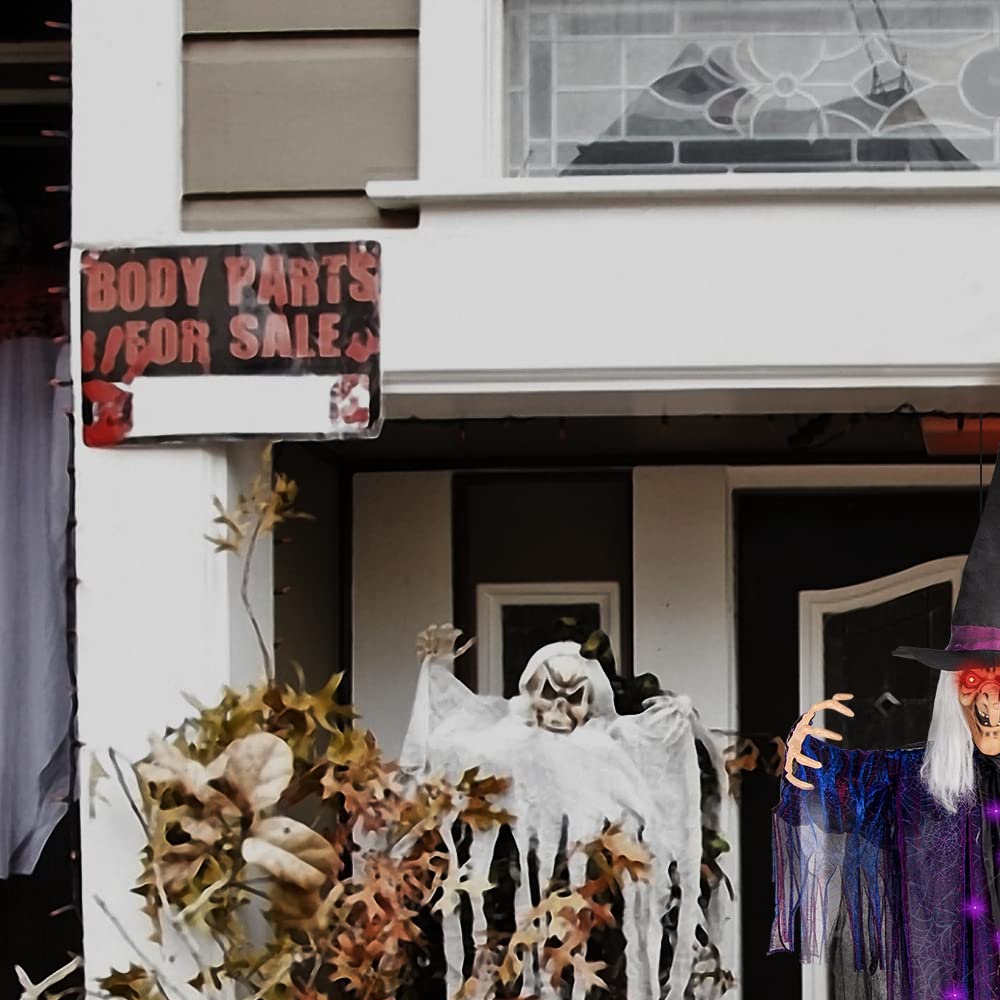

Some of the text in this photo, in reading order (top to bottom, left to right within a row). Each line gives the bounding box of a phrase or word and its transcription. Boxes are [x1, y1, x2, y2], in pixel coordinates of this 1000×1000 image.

[86, 253, 378, 312] BODY PARTS
[124, 312, 341, 365] FOR SALE
